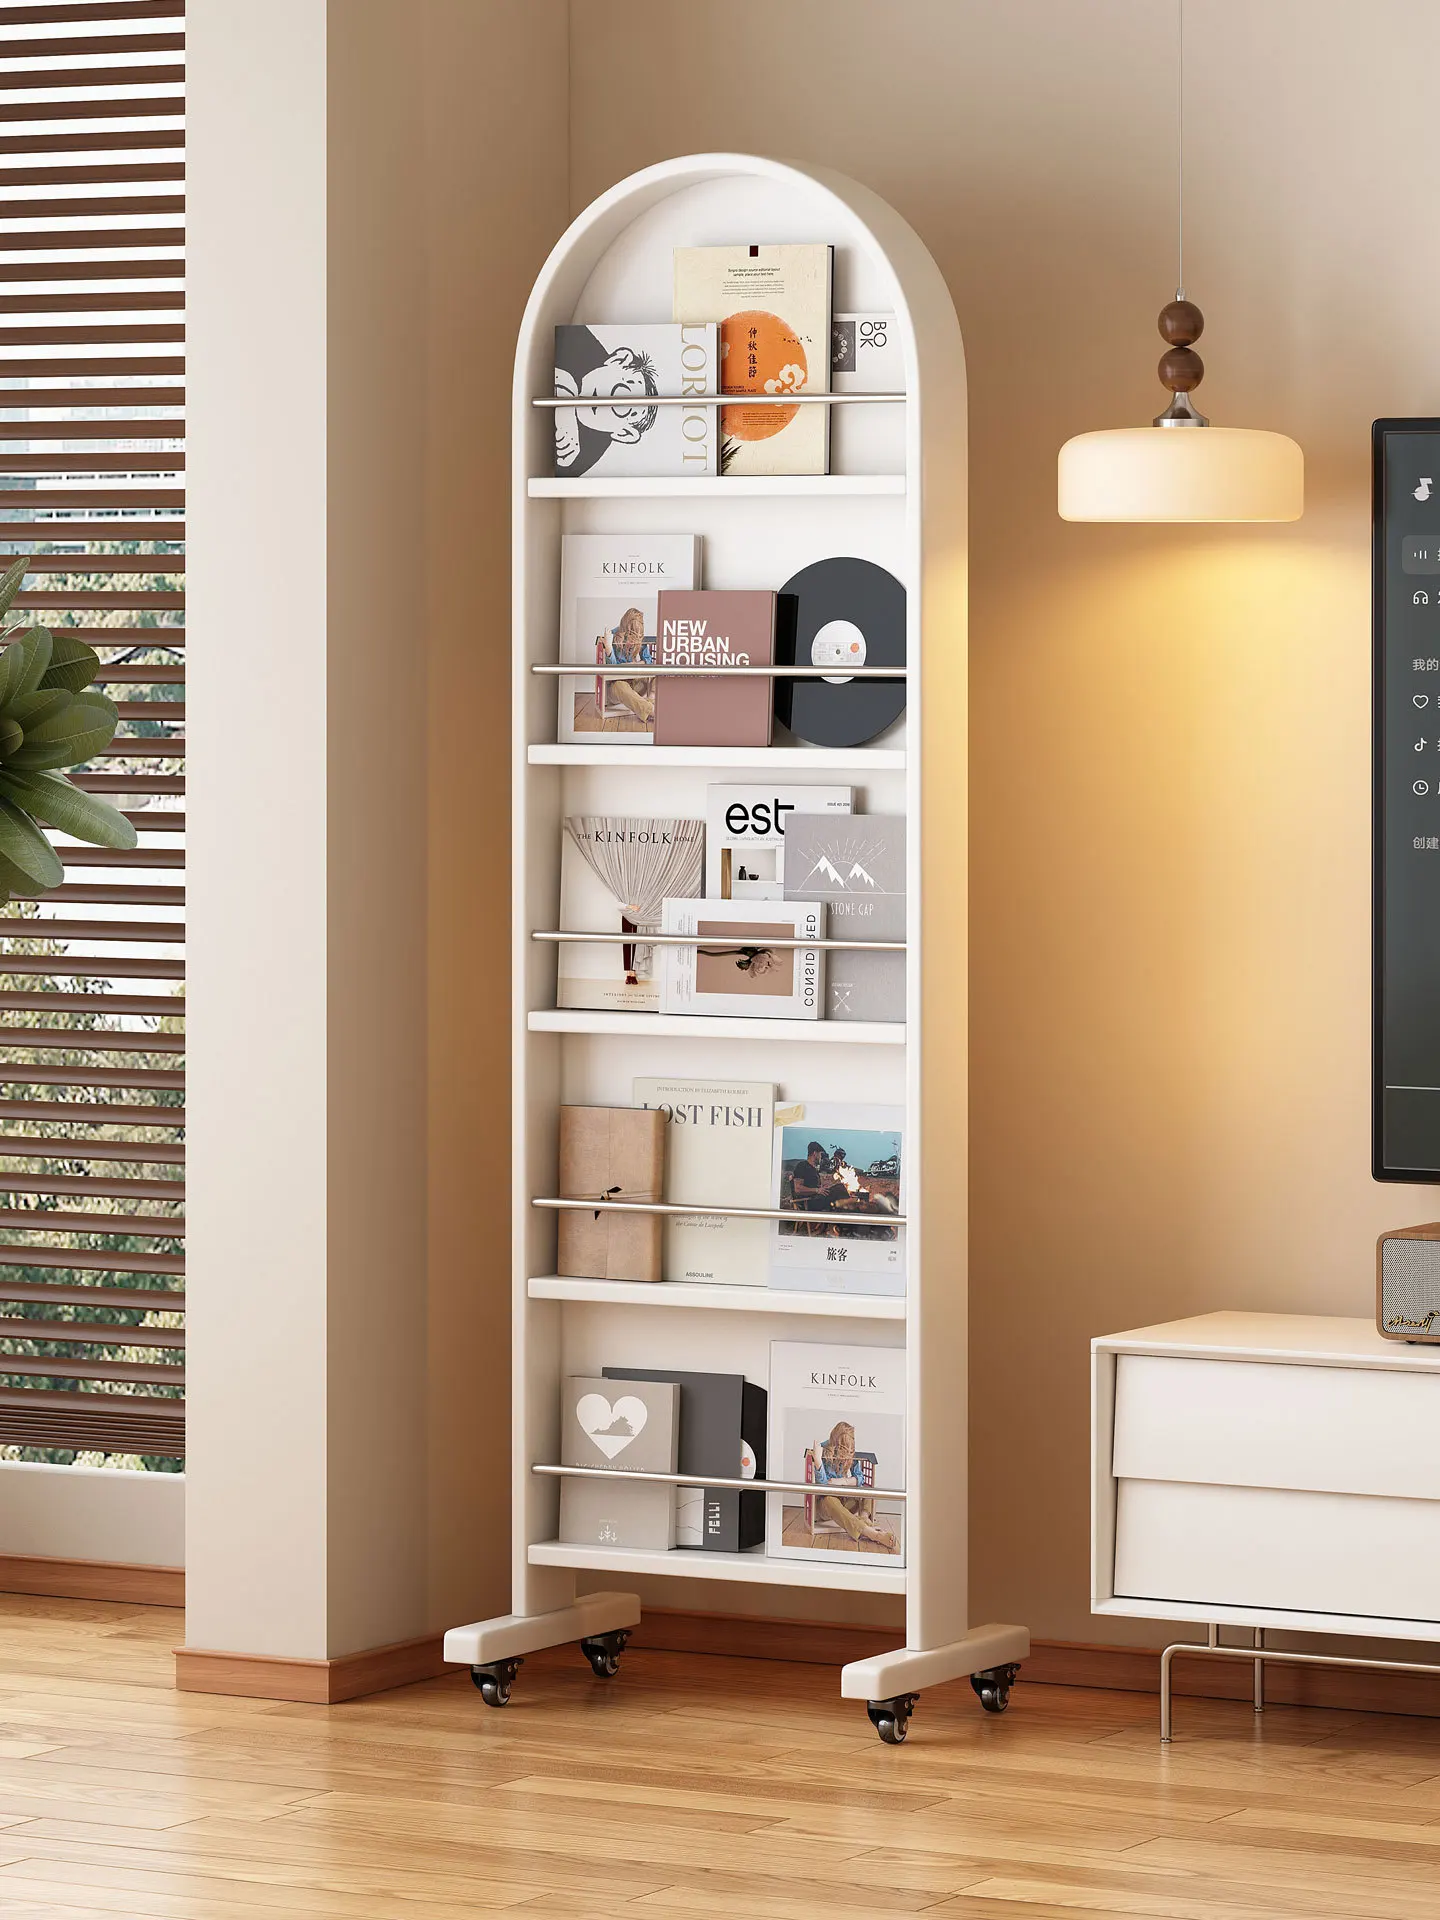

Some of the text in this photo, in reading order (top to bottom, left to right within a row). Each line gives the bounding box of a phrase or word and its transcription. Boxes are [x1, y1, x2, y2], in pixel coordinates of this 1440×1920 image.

[681, 322, 708, 472] LORIOT
[602, 562, 665, 574] KINFOLK
[663, 619, 708, 637] NEW
[662, 636, 730, 653] URBAN
[662, 652, 750, 666] HOUSING
[1412, 658, 1439, 671] 我的
[725, 798, 795, 835] est
[595, 831, 672, 844] KINFOLK
[1412, 836, 1439, 850] 创建
[830, 902, 874, 916] STONE GAP
[710, 1105, 764, 1128] FISH
[826, 1246, 848, 1262] 旅客
[685, 1271, 714, 1279] ASSOULINE
[811, 1372, 877, 1388] KINFOLK
[708, 1502, 721, 1534] FELLI
